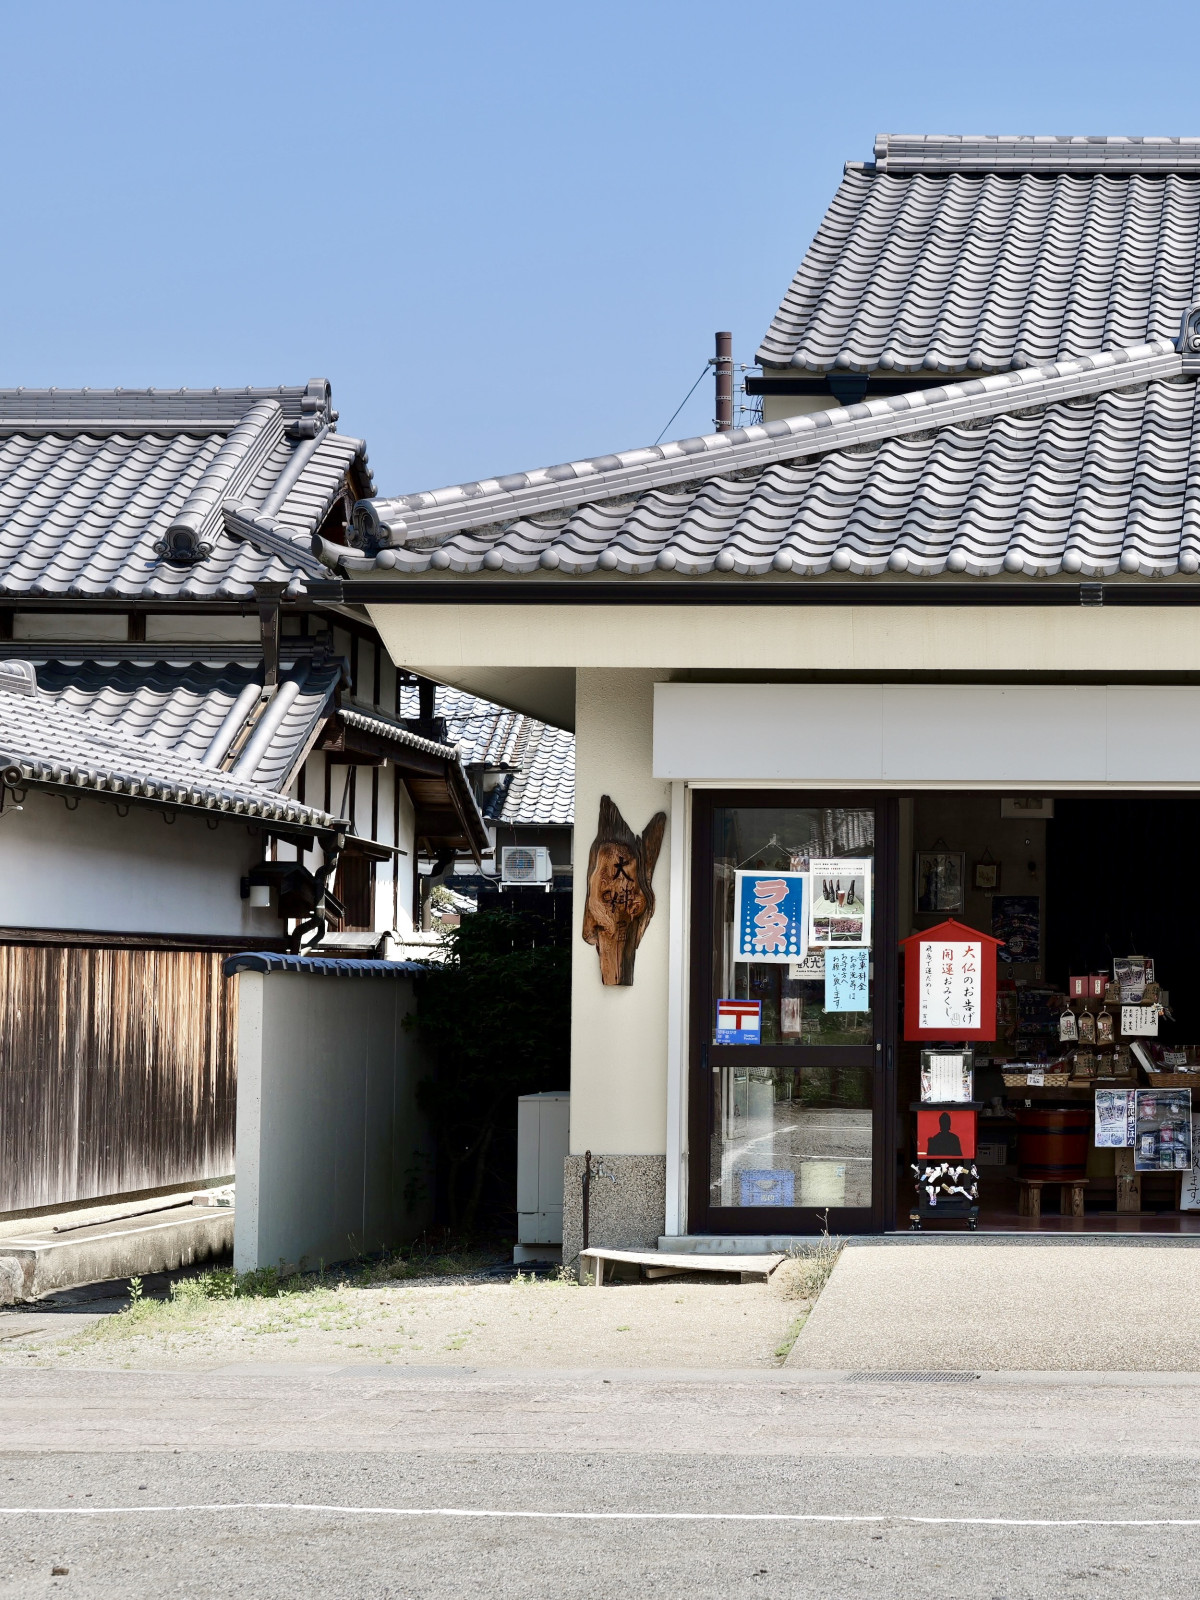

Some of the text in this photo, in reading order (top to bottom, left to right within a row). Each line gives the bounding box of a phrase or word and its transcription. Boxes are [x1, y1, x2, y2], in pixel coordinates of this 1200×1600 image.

[752, 879, 789, 952] ラムネ
[795, 956, 826, 969] 観光
[941, 948, 954, 1017] 開運おみくじ
[961, 945, 976, 1024] 大仏のお告げ
